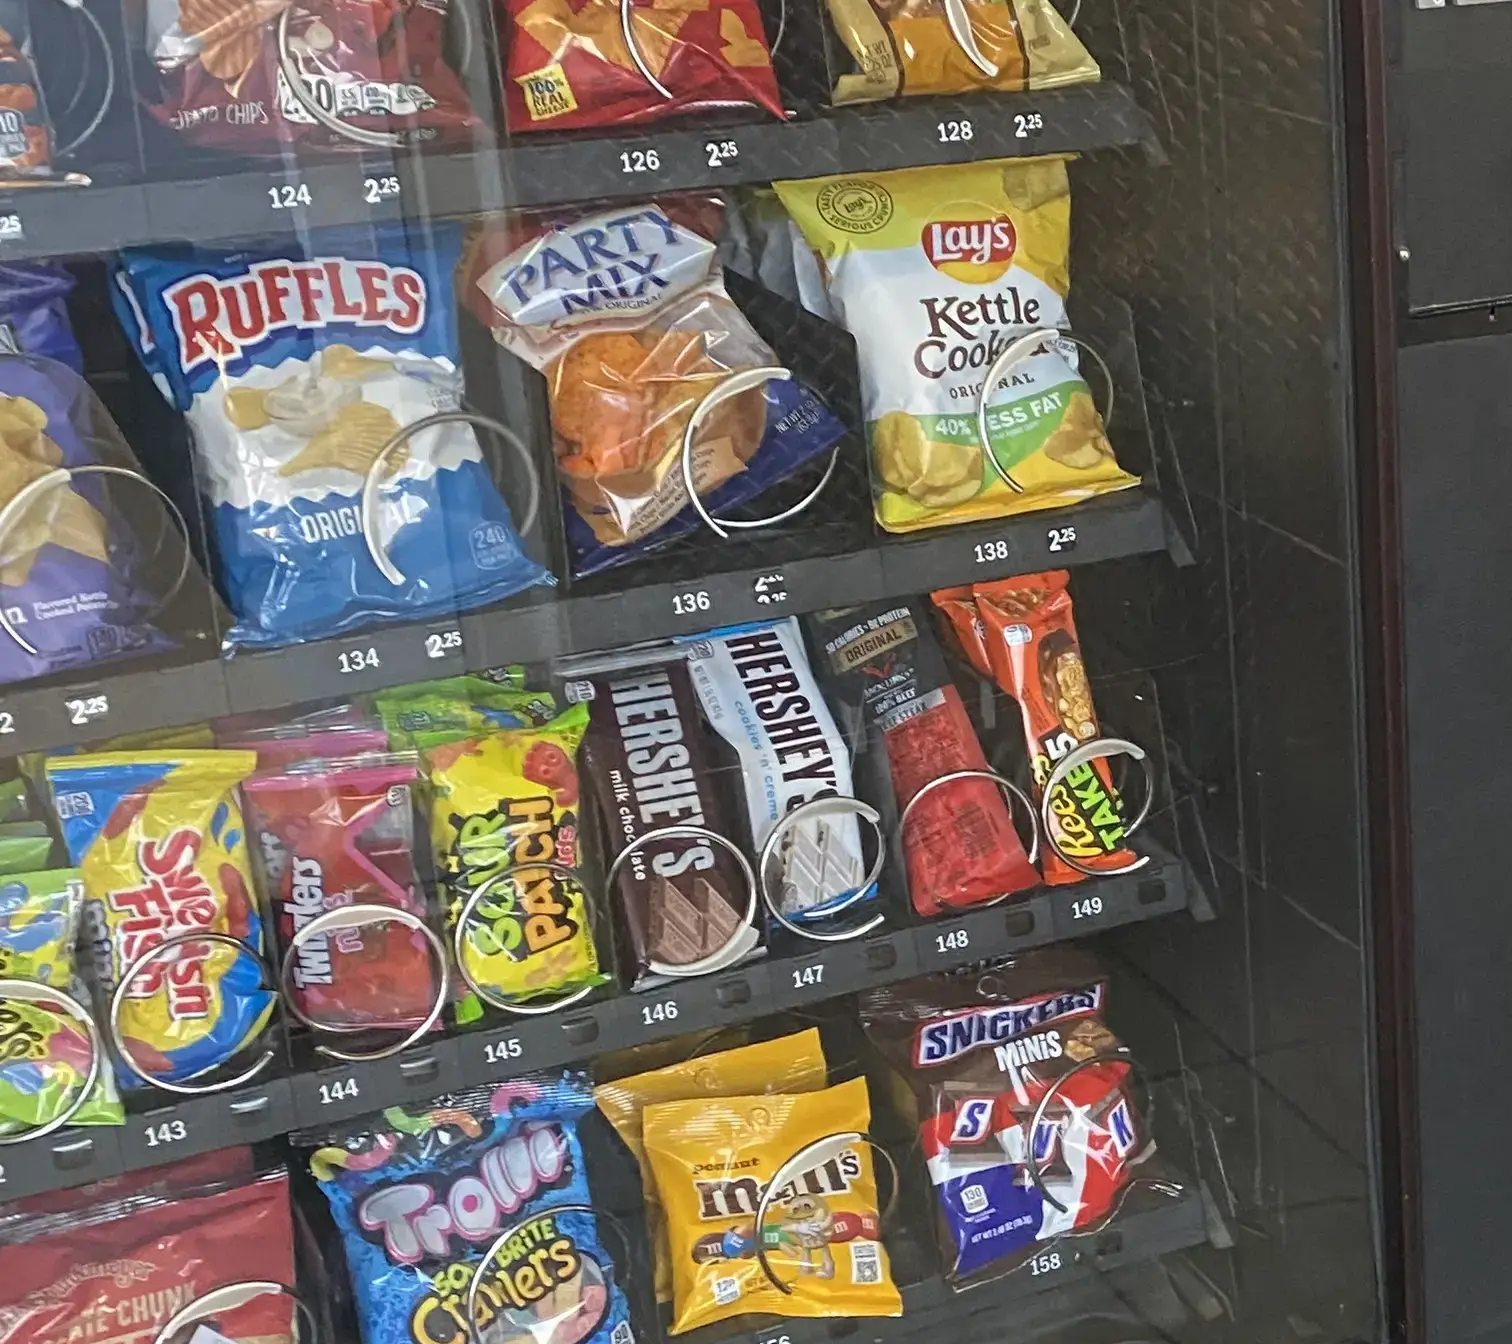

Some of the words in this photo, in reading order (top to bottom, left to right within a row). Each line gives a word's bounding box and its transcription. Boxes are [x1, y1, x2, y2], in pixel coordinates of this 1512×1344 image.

[225, 101, 269, 125] CHIPS
[937, 121, 974, 144] 128
[1013, 114, 1044, 137] 2.25
[619, 150, 661, 174] 126
[706, 142, 739, 168] 2.25
[268, 183, 313, 210] 124
[363, 175, 401, 205] 2.25
[502, 209, 683, 307] PARTY
[931, 217, 1012, 265] Lay's
[559, 252, 670, 315] MIX
[172, 260, 425, 362] RUFFLES
[920, 286, 1041, 341] Kettle
[935, 418, 973, 436] 40%
[1029, 391, 1063, 417] FAT
[299, 494, 429, 545] ORIGIAL
[973, 541, 1009, 564] 138
[1047, 526, 1078, 553] 2.25
[672, 591, 711, 615] 136
[338, 647, 381, 674] 134
[425, 631, 464, 658] 2.25
[843, 627, 903, 664] ORIGINAL
[66, 695, 109, 725] 2.25
[734, 700, 763, 752] cookies
[763, 775, 780, 823] creme
[1044, 733, 1080, 761] 5
[608, 672, 716, 879] HERSHEY'S
[1063, 760, 1125, 851] TAKE
[609, 768, 629, 803] milk
[619, 803, 646, 882] choclate
[506, 795, 578, 954] PATCH
[1071, 895, 1104, 919] 149
[935, 929, 969, 954] 148
[791, 964, 825, 989] 147
[641, 1000, 679, 1025] 146
[919, 983, 1103, 1063] SNICKERS
[483, 1039, 523, 1065] 145
[318, 1079, 360, 1105] 144
[144, 1120, 188, 1147] 143
[957, 1104, 989, 1141] S
[1110, 1103, 1133, 1149] K
[962, 1187, 982, 1202] 130
[1029, 1254, 1063, 1277] 158
